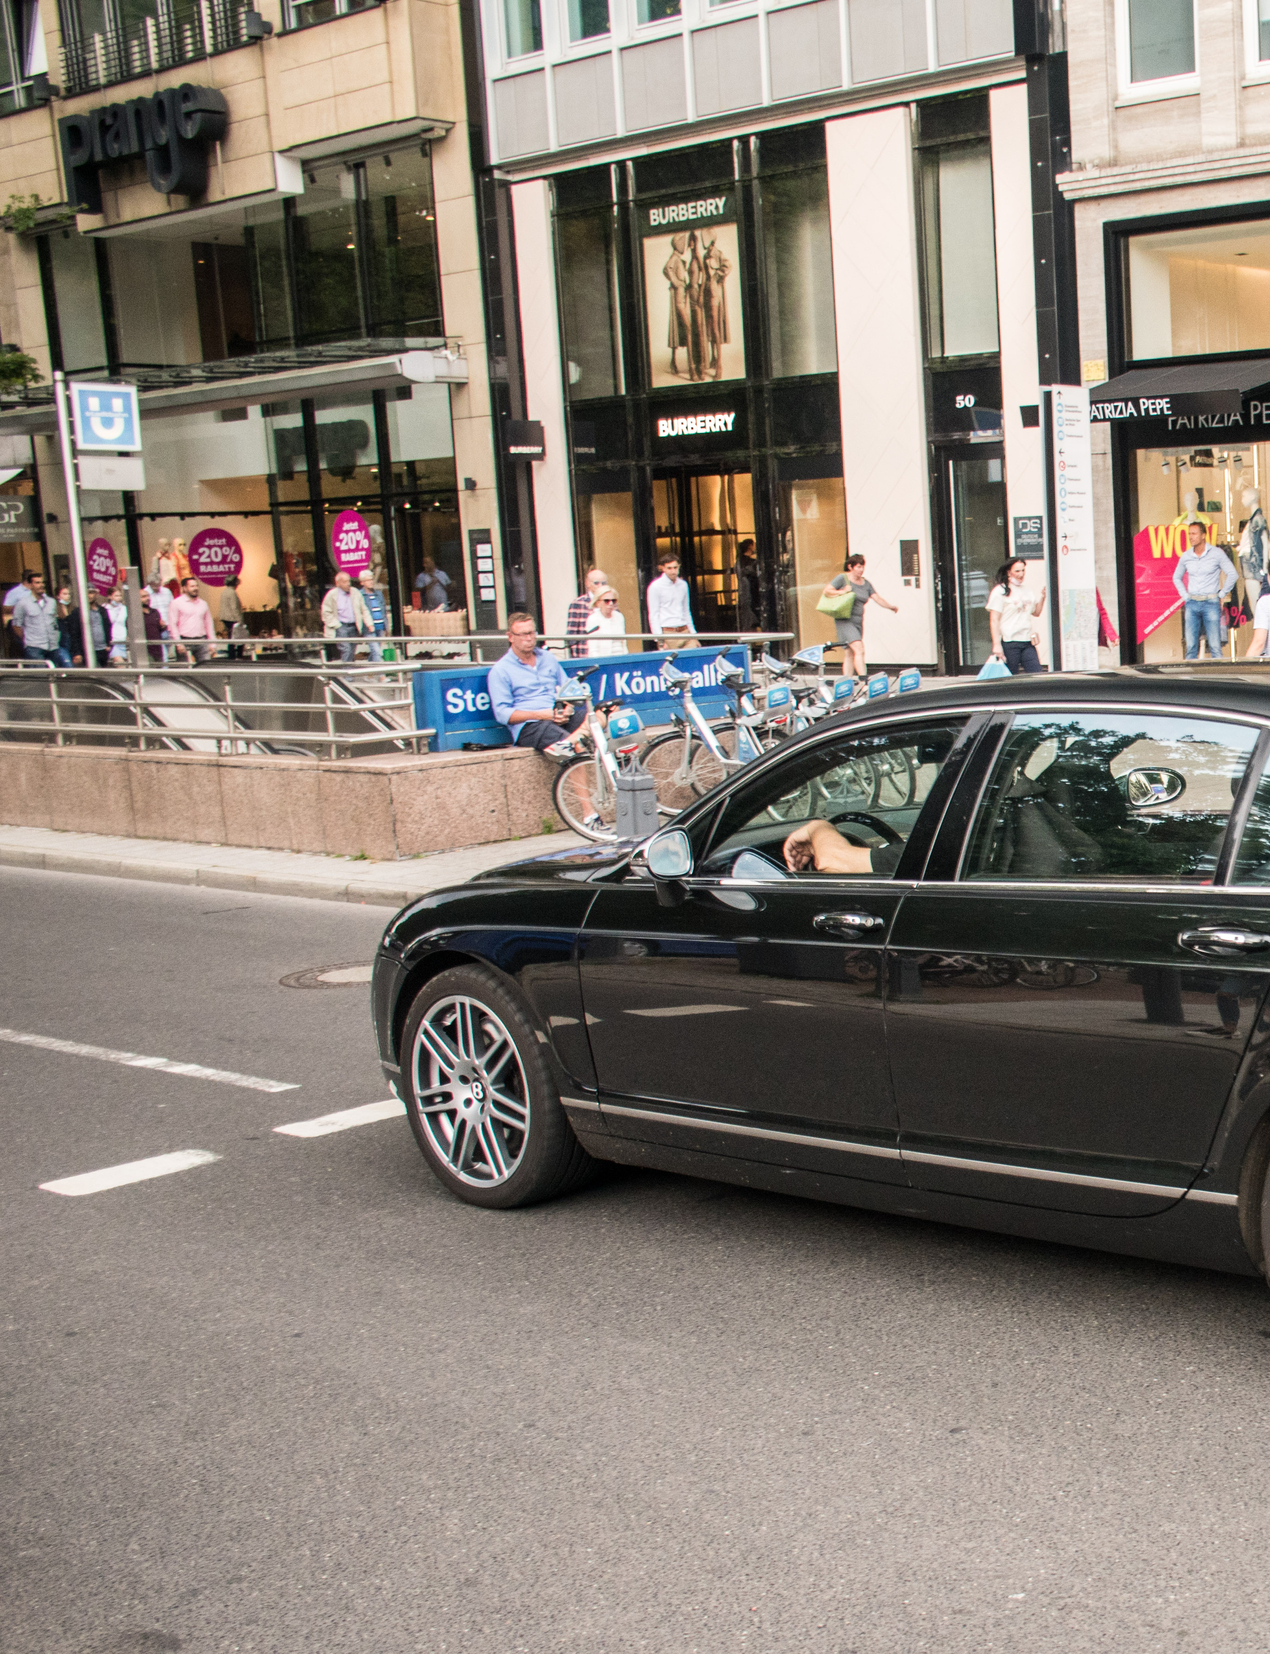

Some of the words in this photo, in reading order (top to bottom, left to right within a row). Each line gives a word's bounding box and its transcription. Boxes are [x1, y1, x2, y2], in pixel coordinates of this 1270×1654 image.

[57, 83, 224, 211] prange
[649, 197, 726, 226] BURBERRY
[955, 394, 975, 408] 50
[1090, 401, 1138, 420] ATRIZIA
[1139, 398, 1172, 416] PEPE
[657, 412, 736, 438] BURBERRY
[342, 521, 359, 530] Jetzt
[1018, 519, 1041, 532] DS
[204, 537, 227, 546] Jetzt
[335, 531, 369, 550] -20%
[192, 546, 240, 563] -20%
[341, 551, 366, 561] RABATT
[89, 555, 116, 575] -20%
[200, 564, 235, 573] RABATT
[93, 572, 113, 584] RABATT
